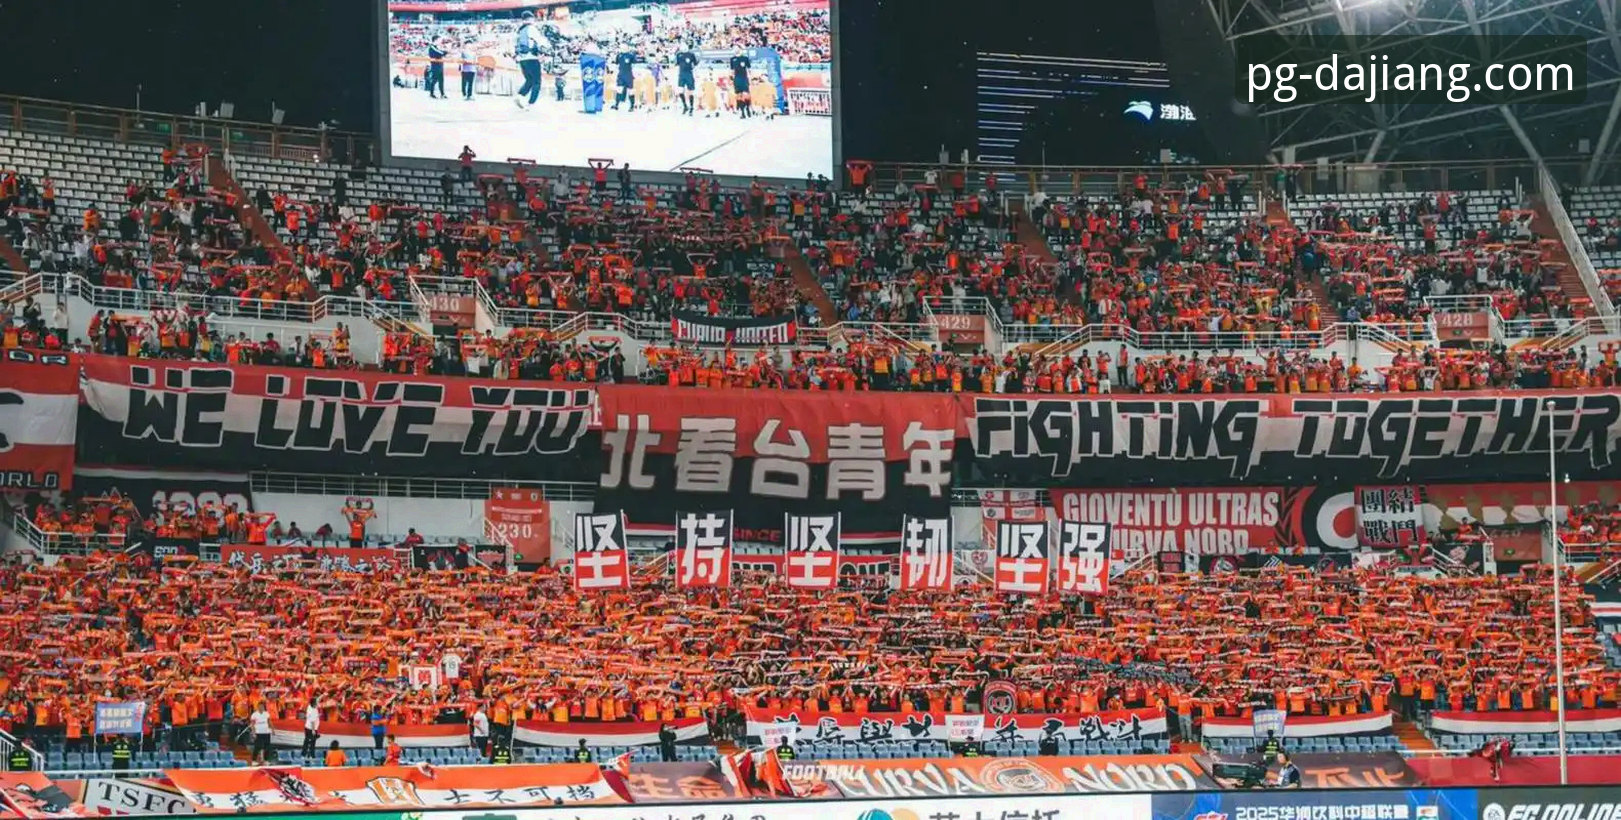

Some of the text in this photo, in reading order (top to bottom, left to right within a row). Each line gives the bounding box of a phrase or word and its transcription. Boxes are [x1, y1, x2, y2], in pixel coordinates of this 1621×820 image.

[122, 364, 234, 447] WE
[254, 373, 444, 457] LOVE
[461, 385, 597, 456] YOU
[975, 393, 1621, 479] FIGHTING TOGETHER
[600, 413, 955, 500] 北看台青年
[498, 523, 532, 539] 230
[1112, 528, 1249, 556] URVA NORD
[1188, 491, 1279, 526] ULTRAS
[576, 514, 623, 588] 坚
[680, 513, 726, 585] 持
[789, 516, 835, 587] 坚
[906, 517, 949, 587] 韧
[999, 523, 1045, 592] 坚
[1062, 523, 1106, 593] 强
[98, 781, 186, 814] TSFC
[783, 764, 866, 781] FOOTBALL
[1062, 761, 1197, 793] NORD
